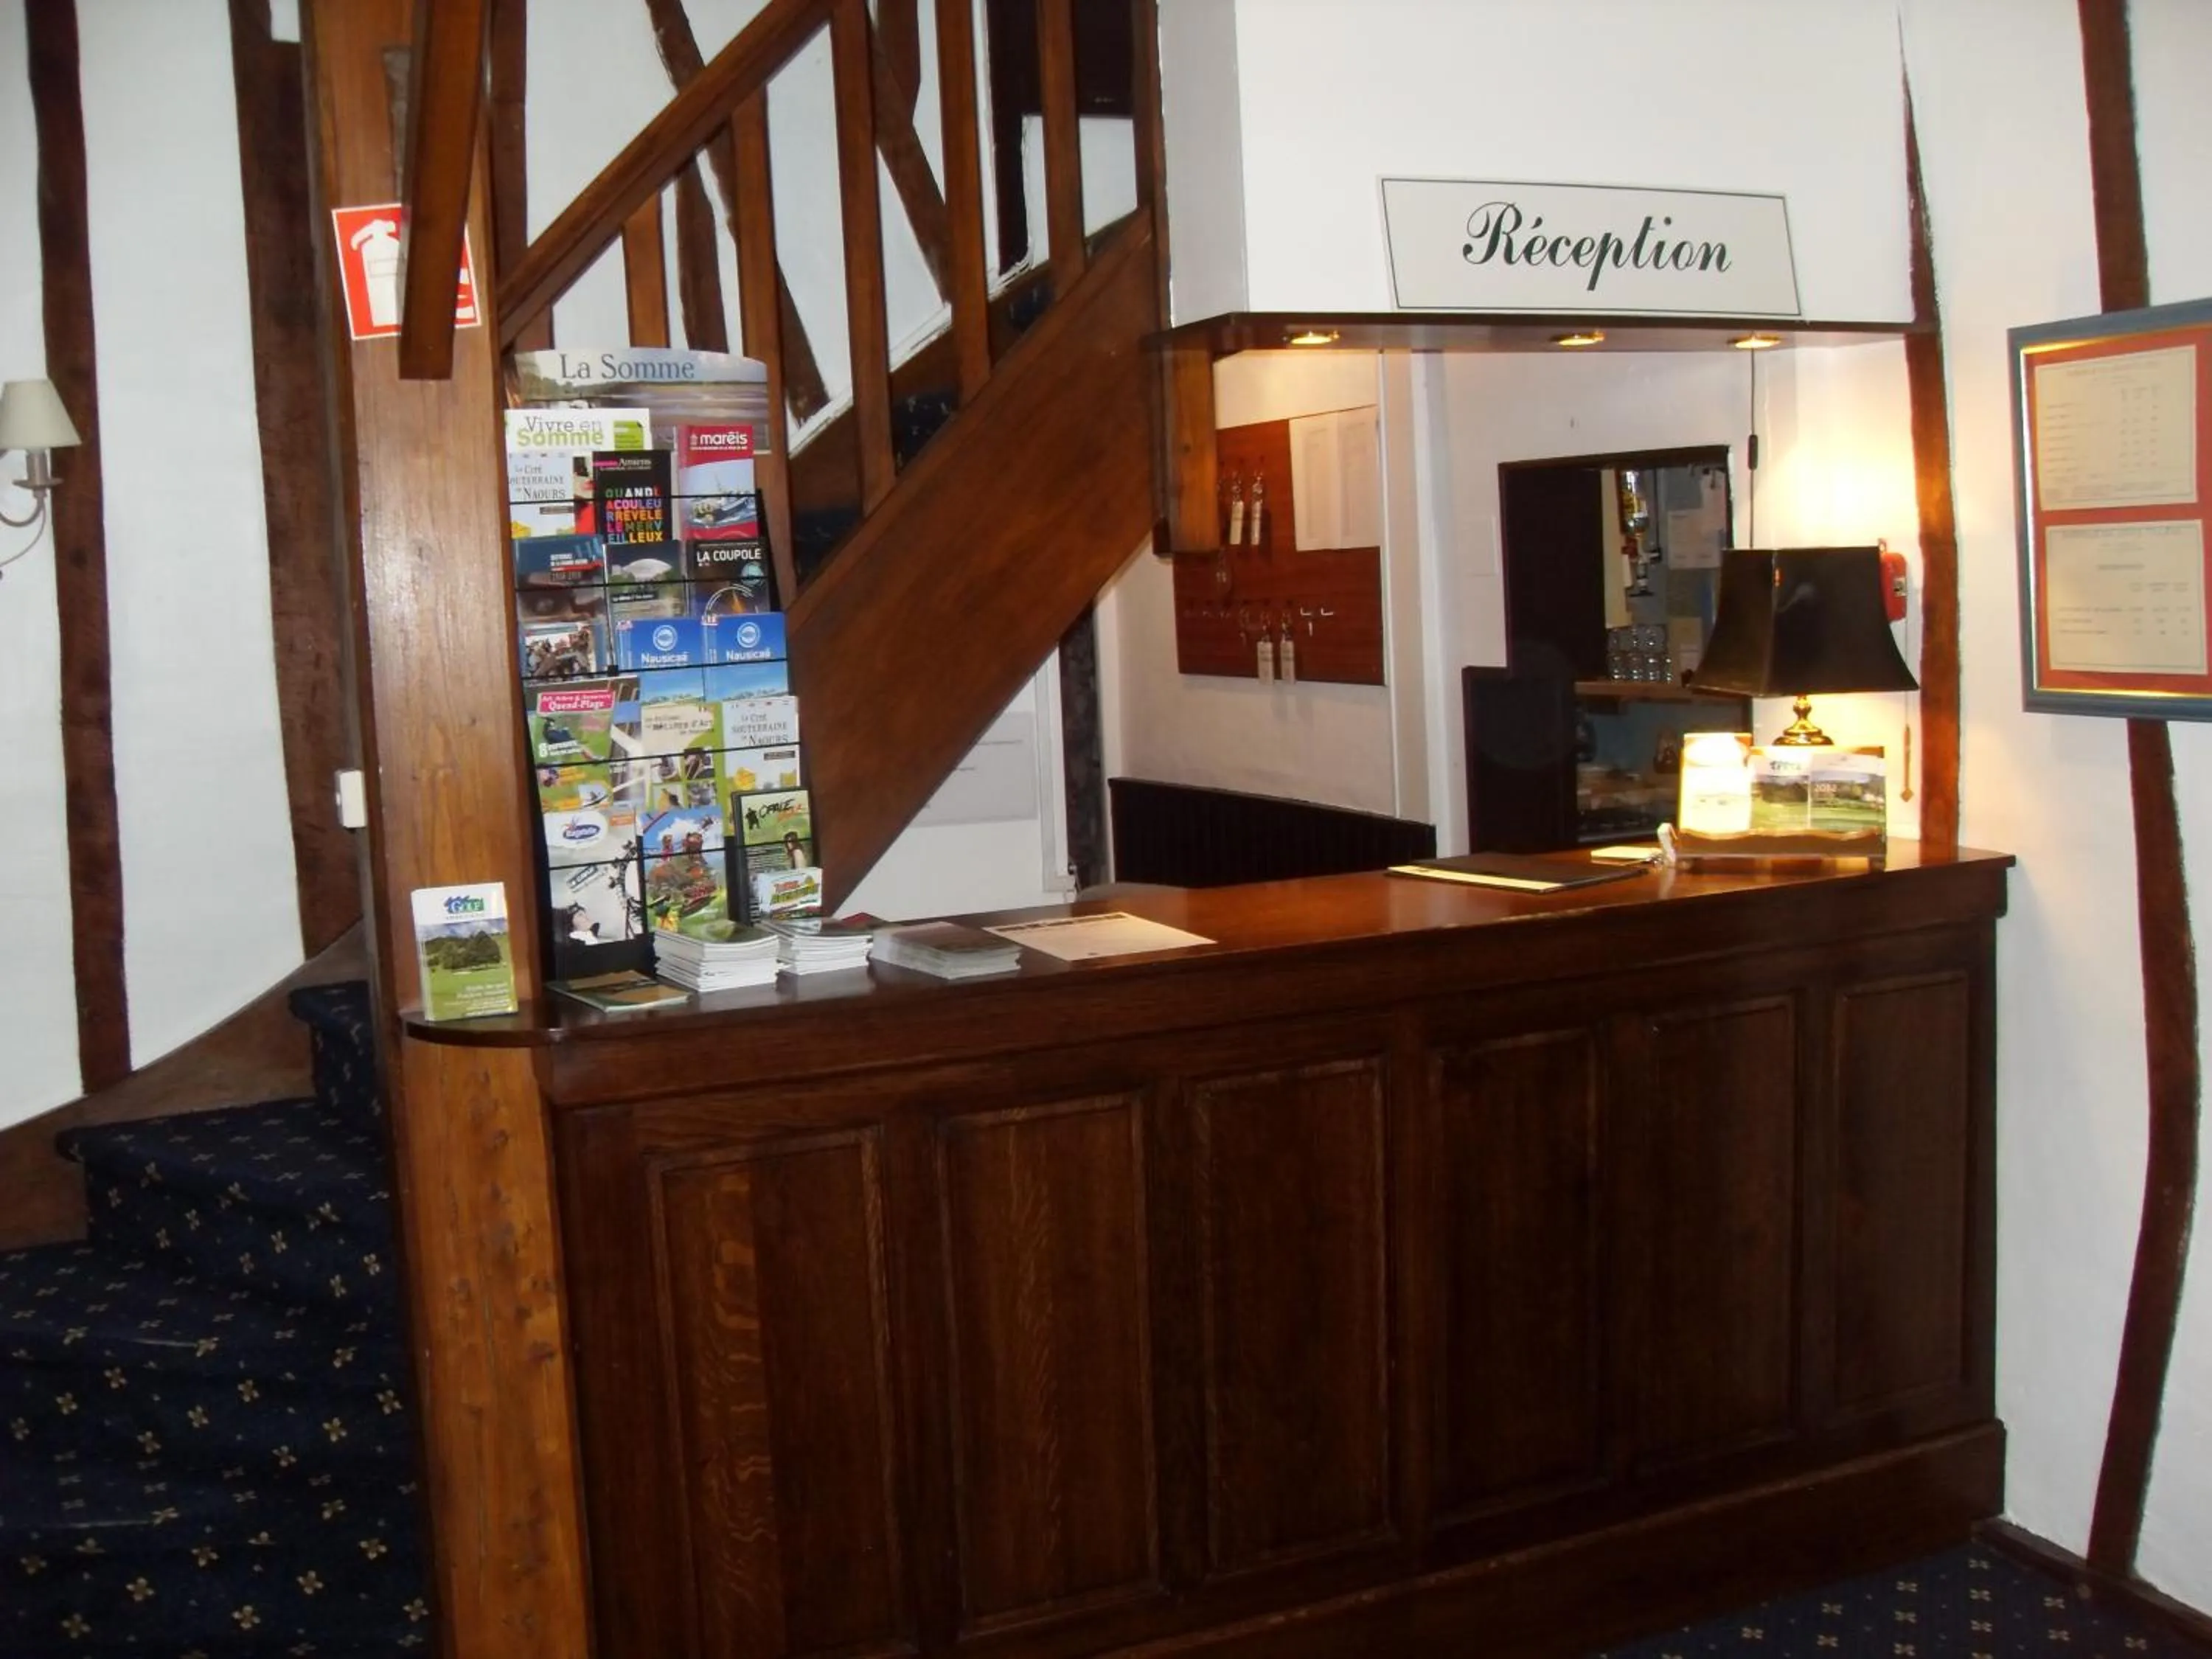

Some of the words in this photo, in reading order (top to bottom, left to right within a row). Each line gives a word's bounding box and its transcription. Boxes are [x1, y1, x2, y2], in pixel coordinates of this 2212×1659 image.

[1463, 201, 1731, 291] Réception
[560, 353, 591, 379] La
[601, 353, 695, 379] Somme
[525, 417, 574, 433] Vivre
[518, 427, 604, 446] Somme
[697, 552, 710, 563] LA
[713, 549, 762, 561] COUPOLE
